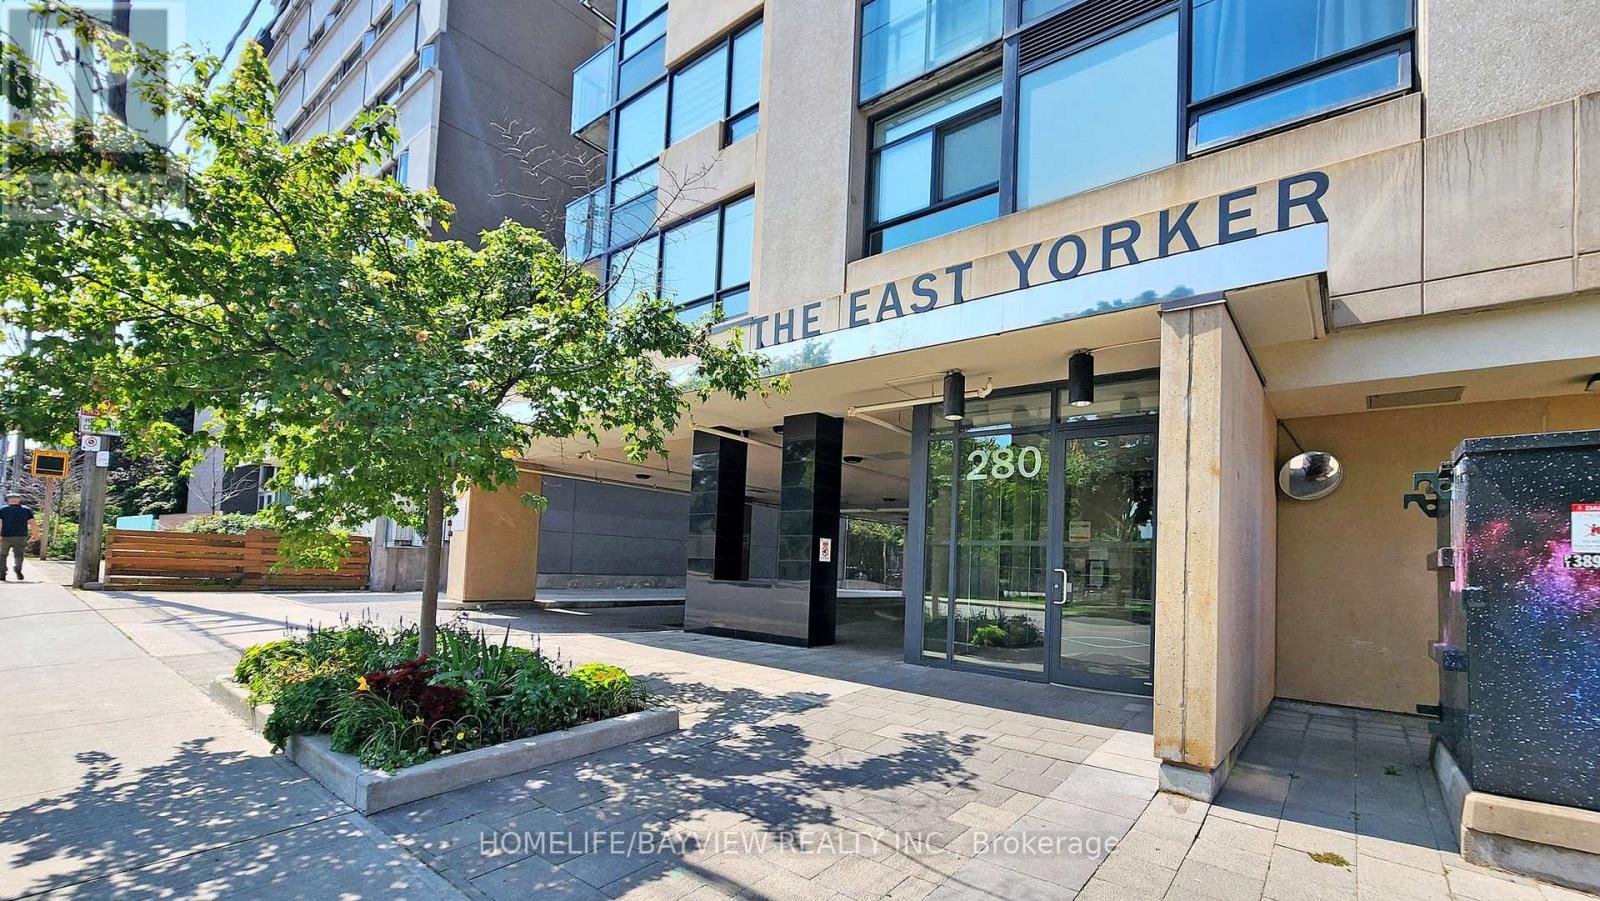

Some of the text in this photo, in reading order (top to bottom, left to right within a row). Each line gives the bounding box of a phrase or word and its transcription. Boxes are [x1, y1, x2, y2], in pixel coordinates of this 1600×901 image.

[750, 171, 1330, 350] THE EAST YORKER
[966, 446, 1042, 480] 280
